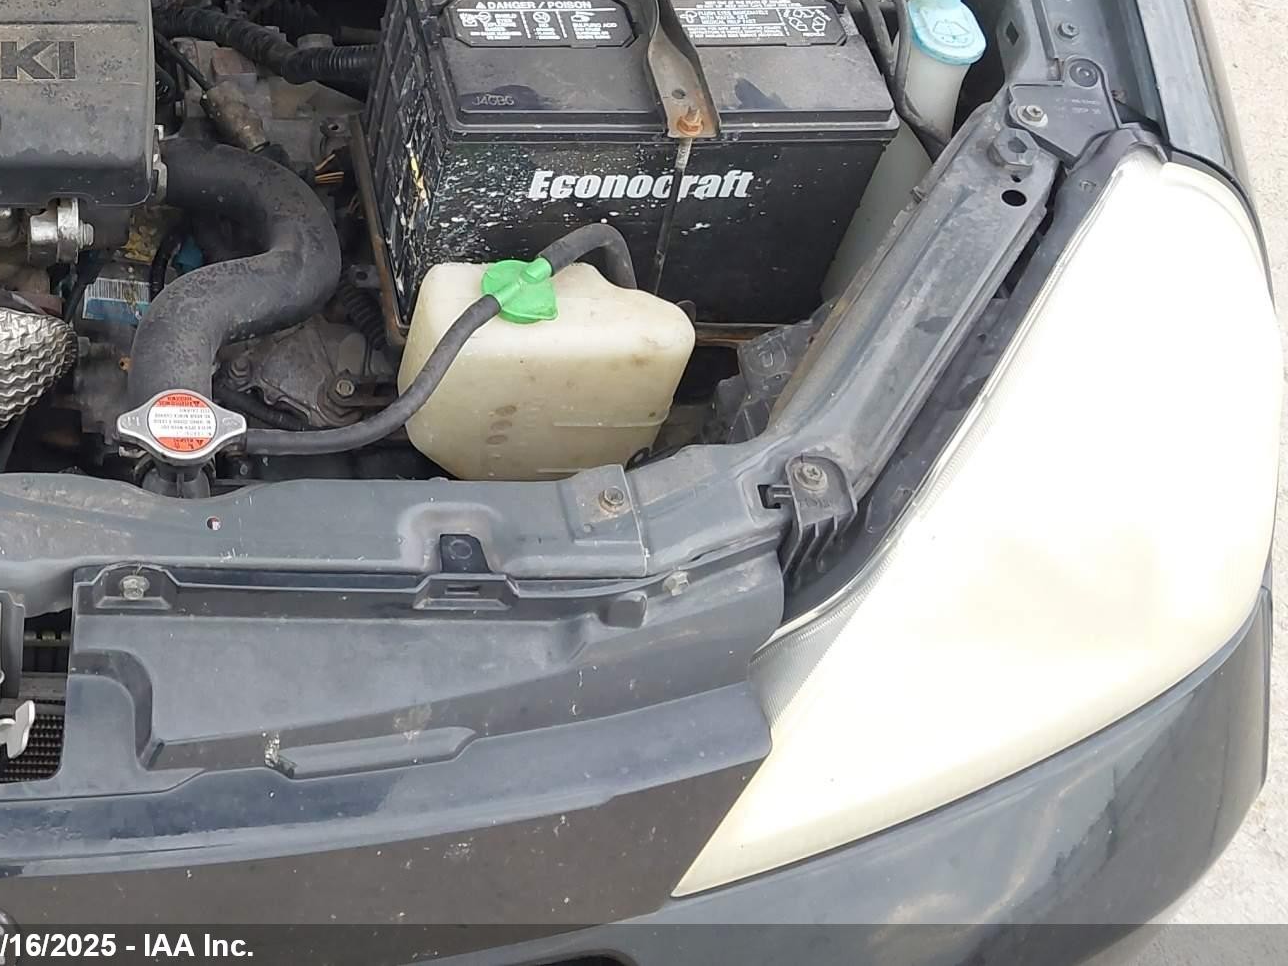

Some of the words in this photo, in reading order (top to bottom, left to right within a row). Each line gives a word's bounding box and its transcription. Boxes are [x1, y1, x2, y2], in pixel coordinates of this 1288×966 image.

[487, 1, 536, 10] DANGER
[547, 0, 592, 9] POISON
[528, 169, 754, 199] Econocraft
